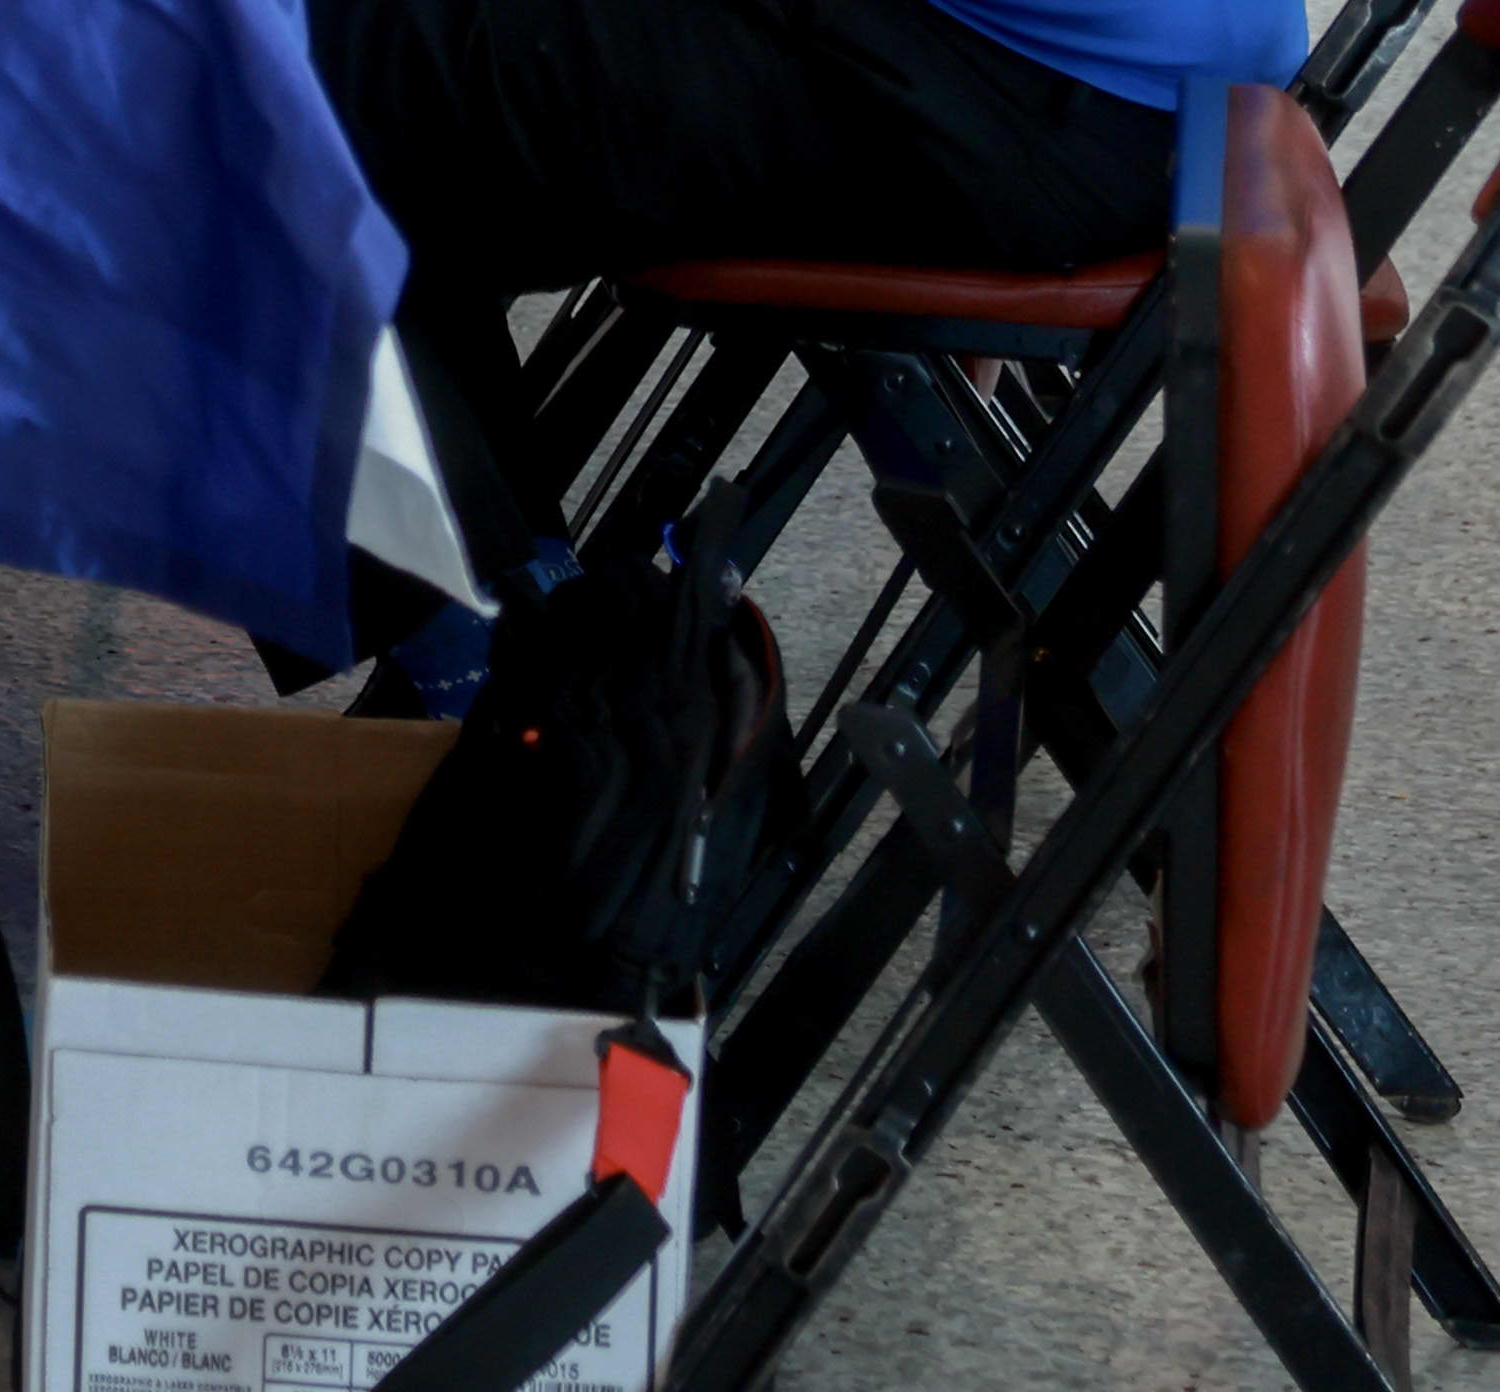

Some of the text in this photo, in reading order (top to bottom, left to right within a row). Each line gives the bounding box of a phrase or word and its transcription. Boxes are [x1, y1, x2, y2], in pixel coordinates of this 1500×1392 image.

[246, 1144, 542, 1197] 642G0310A
[173, 1227, 375, 1267] XEROGRAPHIC
[384, 1246, 463, 1273] COPY
[146, 1257, 235, 1289] PAPEL
[243, 1265, 280, 1291] DE
[288, 1269, 374, 1299] COPIA
[120, 1287, 220, 1319] PAPIER
[229, 1295, 266, 1322] DE
[273, 1299, 360, 1330] COPIE
[107, 1345, 170, 1367] BLANCO
[181, 1351, 233, 1373] BLANC
[143, 1328, 197, 1351] WHITE
